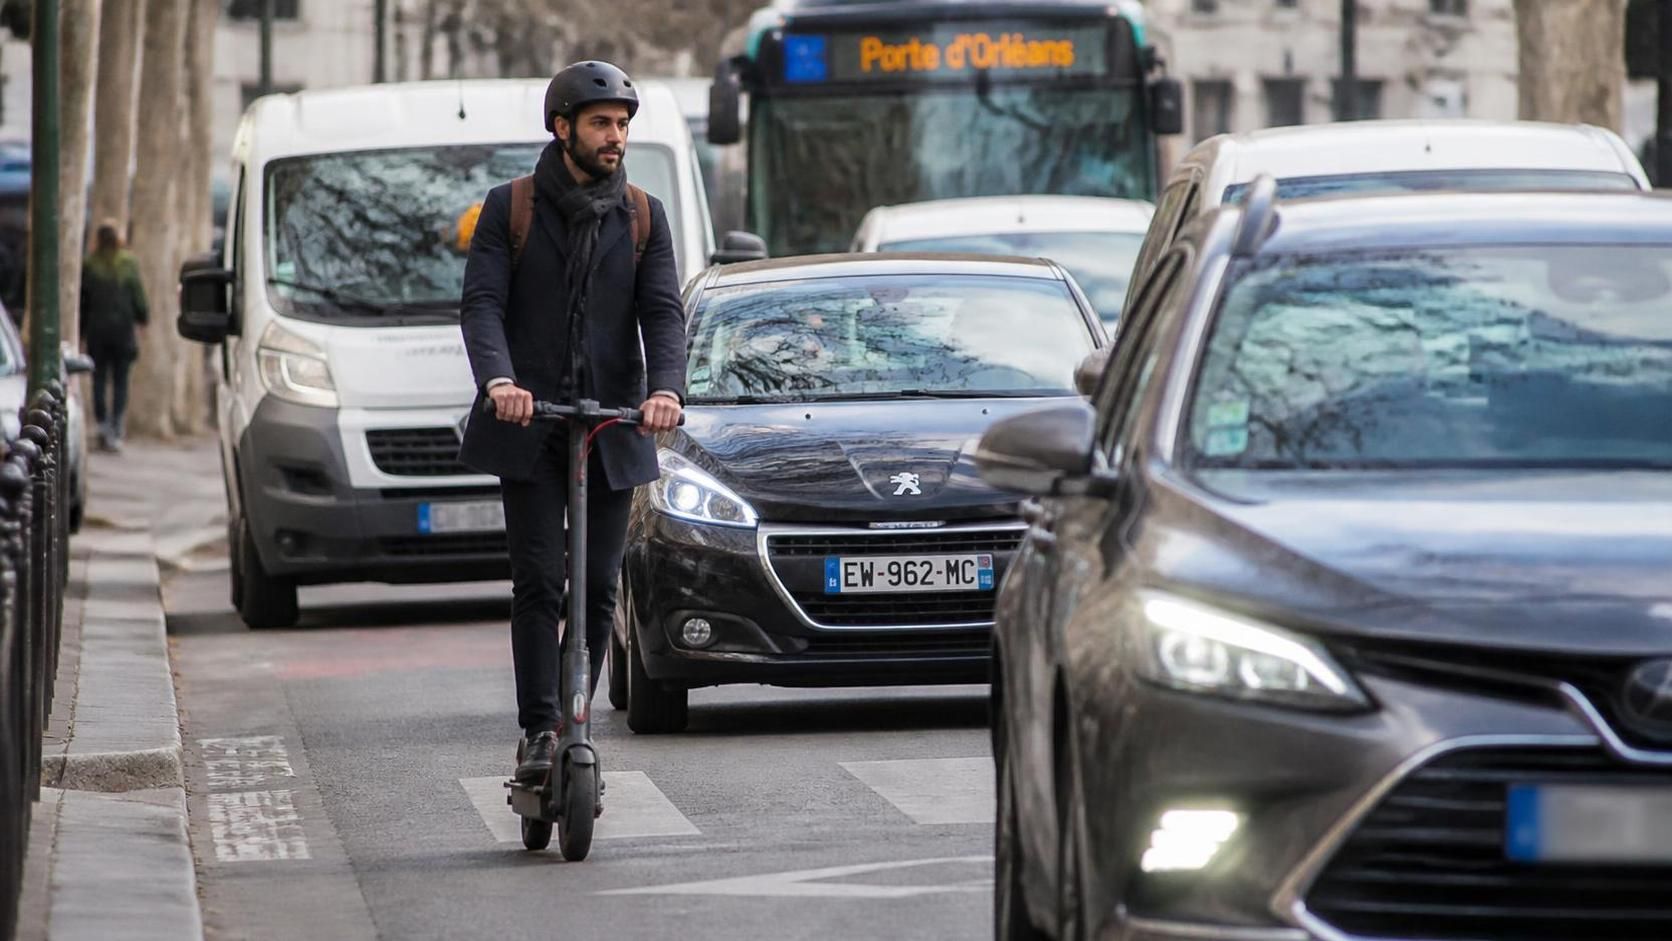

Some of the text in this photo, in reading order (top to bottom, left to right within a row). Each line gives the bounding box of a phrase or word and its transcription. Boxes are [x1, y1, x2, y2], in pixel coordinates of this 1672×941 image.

[861, 33, 1074, 72] Porte d'Orléans
[843, 559, 976, 588] EW-962-MC
